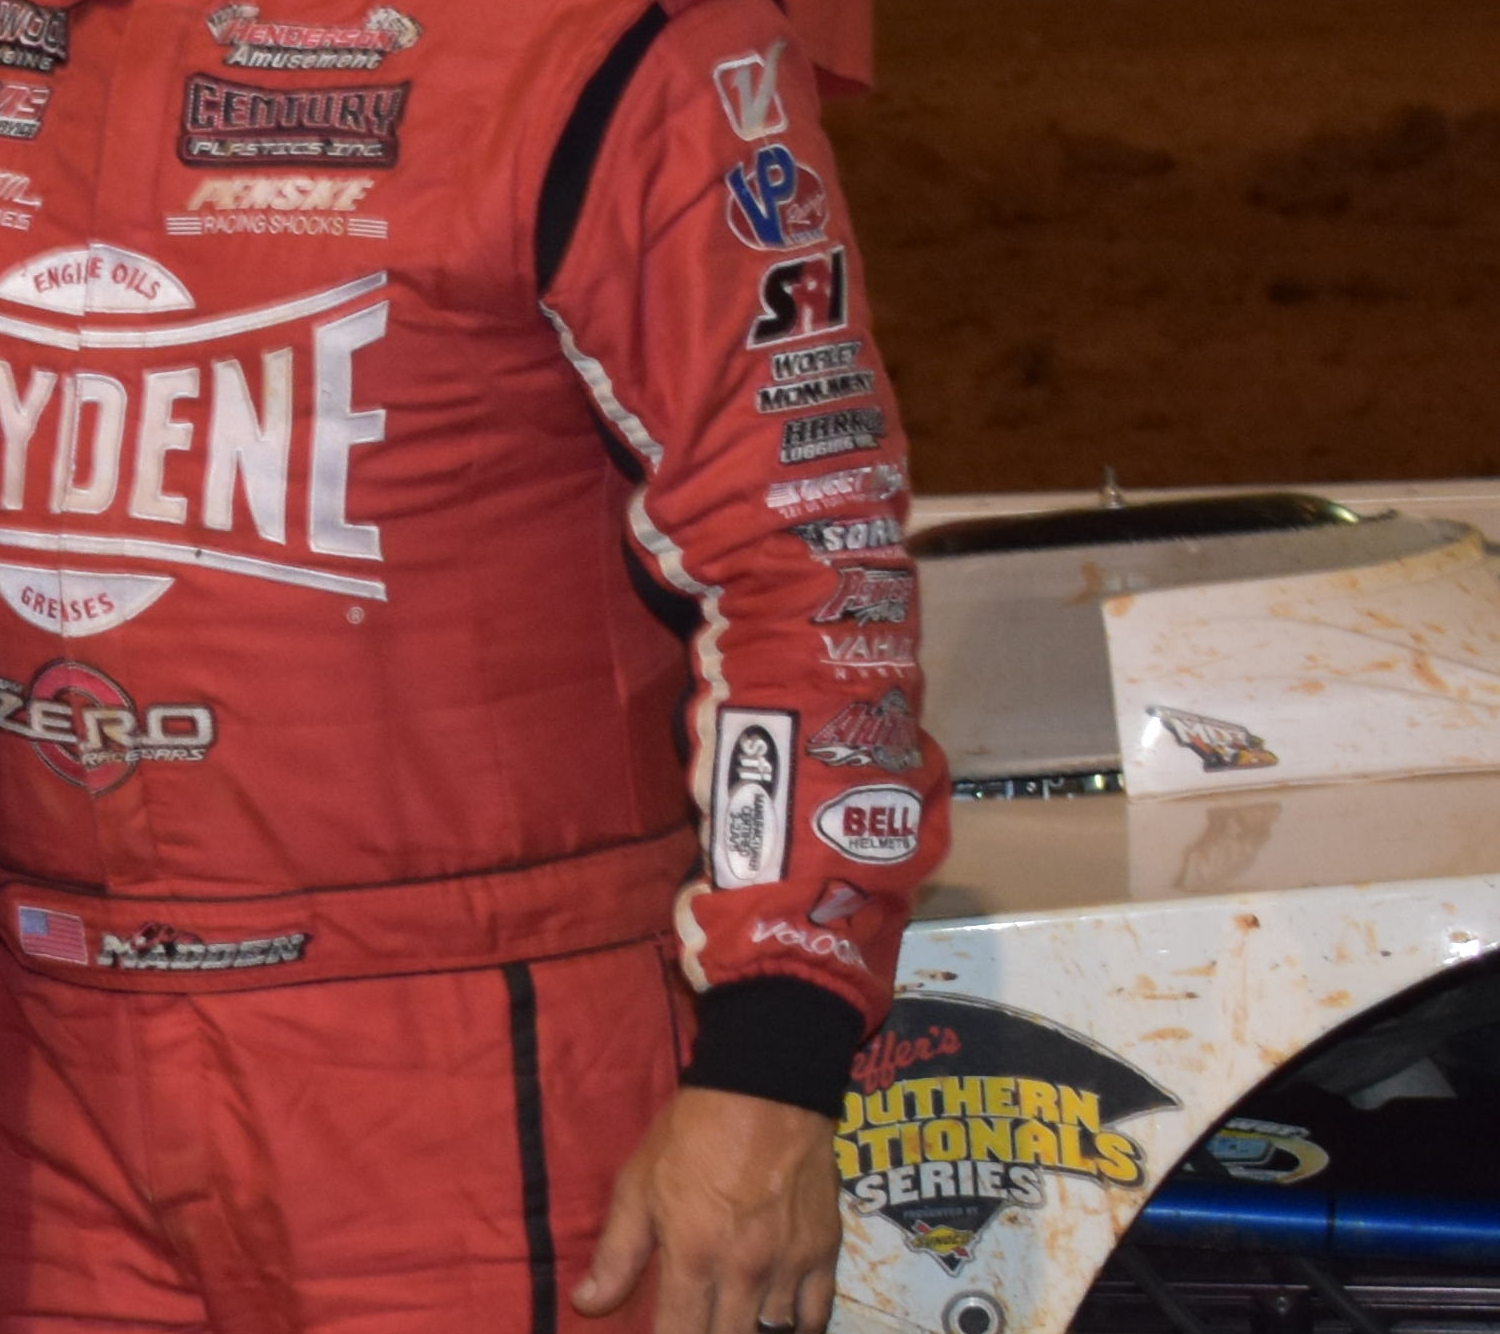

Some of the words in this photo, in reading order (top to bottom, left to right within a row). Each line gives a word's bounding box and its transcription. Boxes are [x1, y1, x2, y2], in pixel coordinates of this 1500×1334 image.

[227, 45, 383, 70] Amusement
[187, 78, 407, 136] CENTURY
[192, 141, 324, 158] PLASTICS
[187, 176, 376, 213] PENSKE
[203, 215, 267, 235] RACING
[268, 217, 345, 236] SHOCKS
[110, 262, 162, 302] OILS
[842, 805, 916, 838] BELL
[848, 837, 912, 851] HELMETS
[834, 1115, 1146, 1184] ATIONALS
[853, 1161, 1045, 1215] SERIES
